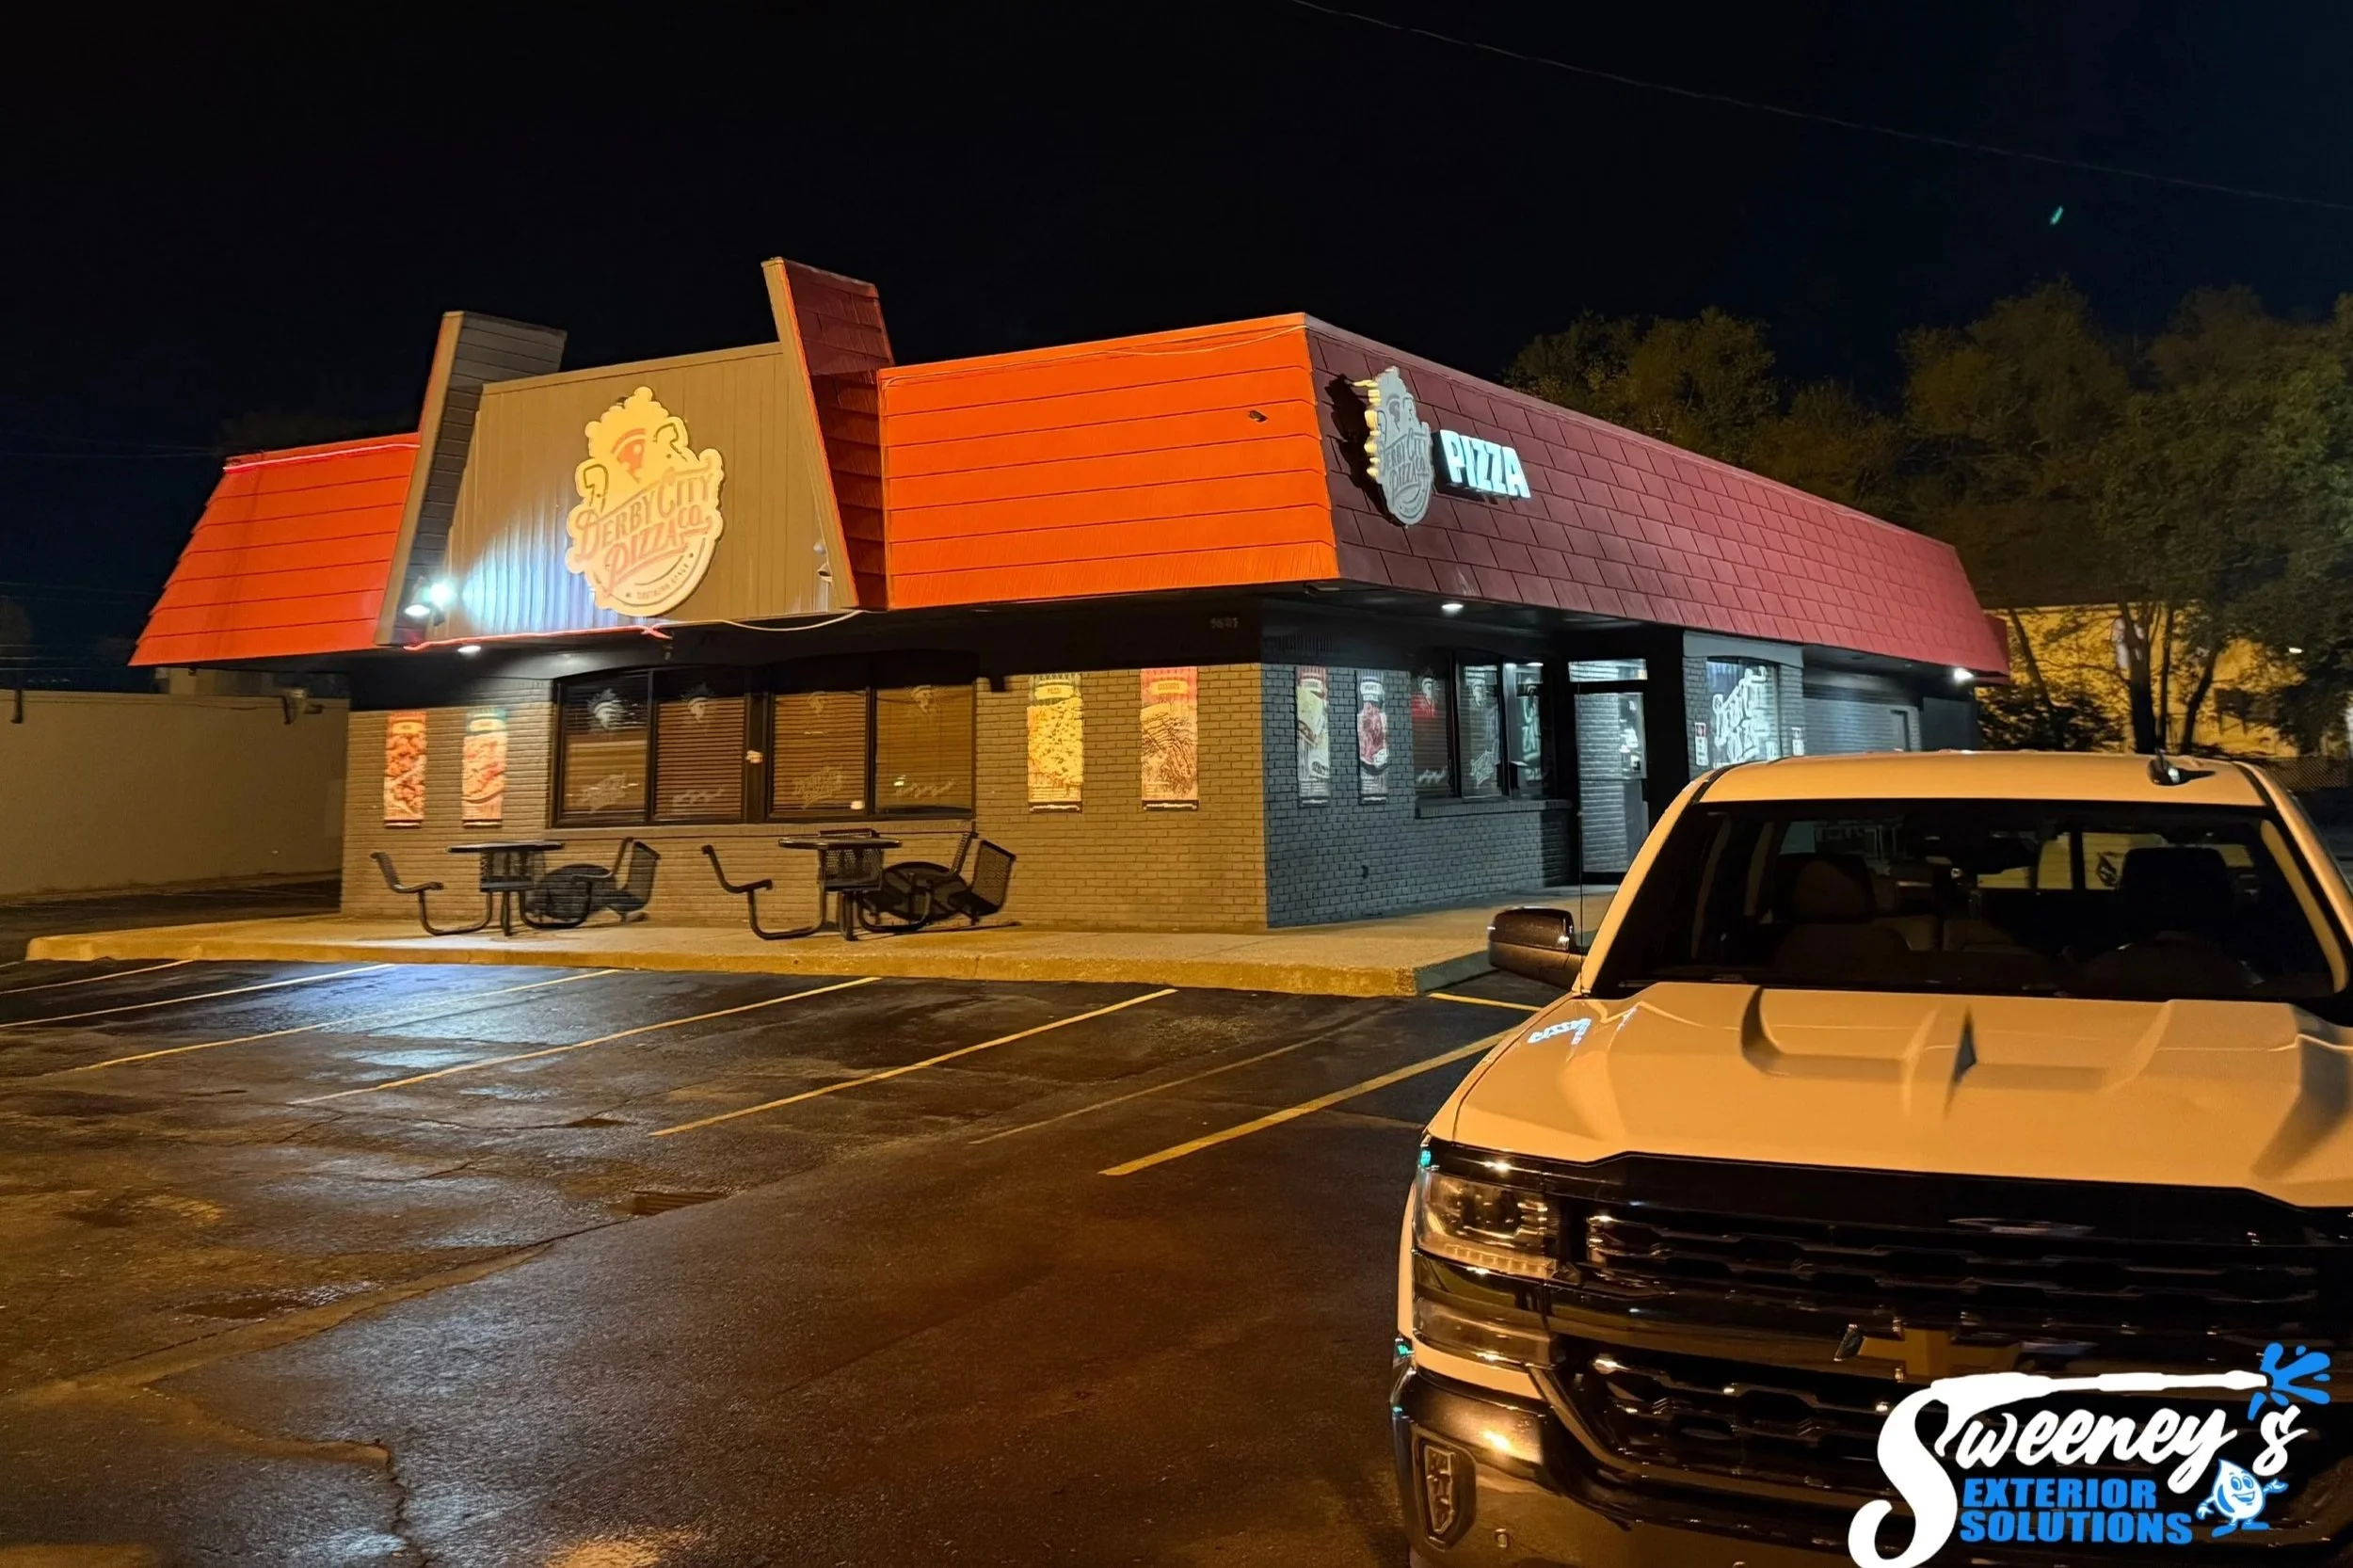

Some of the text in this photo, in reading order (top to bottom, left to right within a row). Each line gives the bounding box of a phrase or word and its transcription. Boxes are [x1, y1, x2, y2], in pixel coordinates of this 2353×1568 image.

[1389, 460, 1417, 506] PIZZA
[1440, 429, 1531, 499] PIZZA
[576, 467, 714, 561] DERBY CITY
[603, 520, 683, 597] PIZZA
